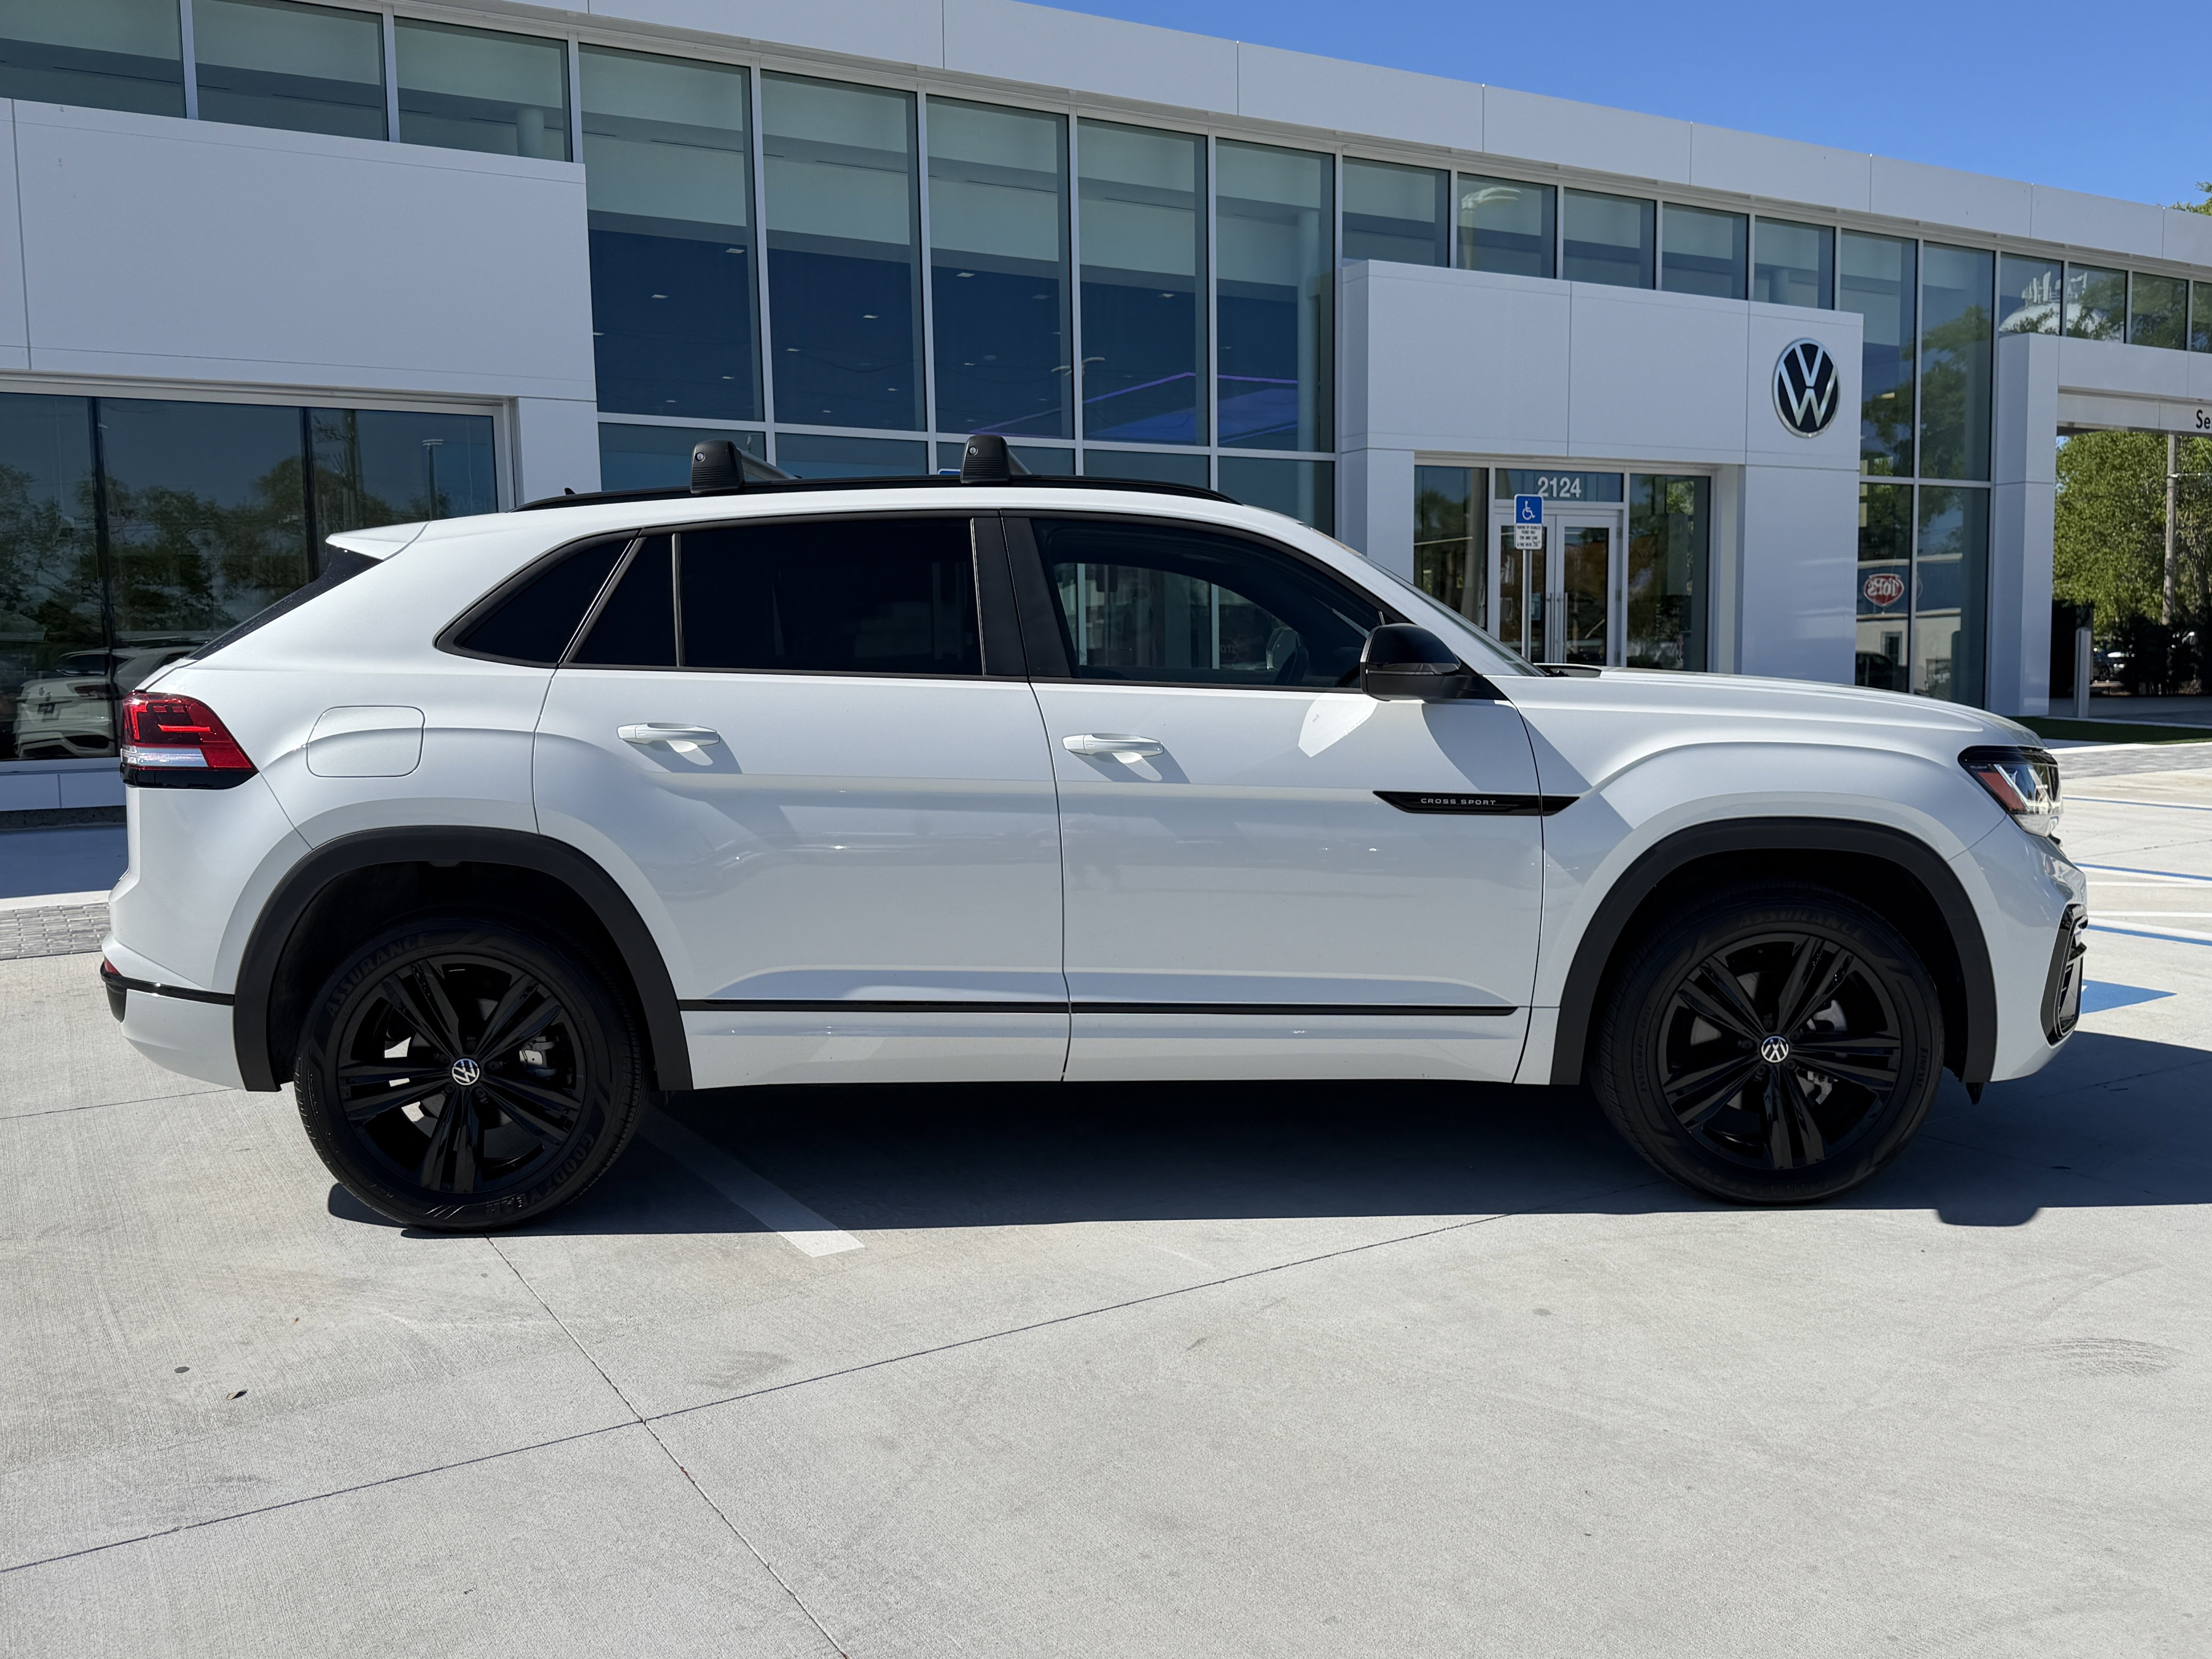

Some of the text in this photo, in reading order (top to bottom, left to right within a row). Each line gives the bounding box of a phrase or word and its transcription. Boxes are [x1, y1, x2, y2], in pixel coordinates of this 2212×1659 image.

[1774, 339, 1840, 436] VW
[2196, 409, 2212, 429] Se
[1537, 476, 1581, 498] 2124
[1739, 910, 1864, 939] ASSURANCE
[325, 931, 429, 1018] ASSURANCE
